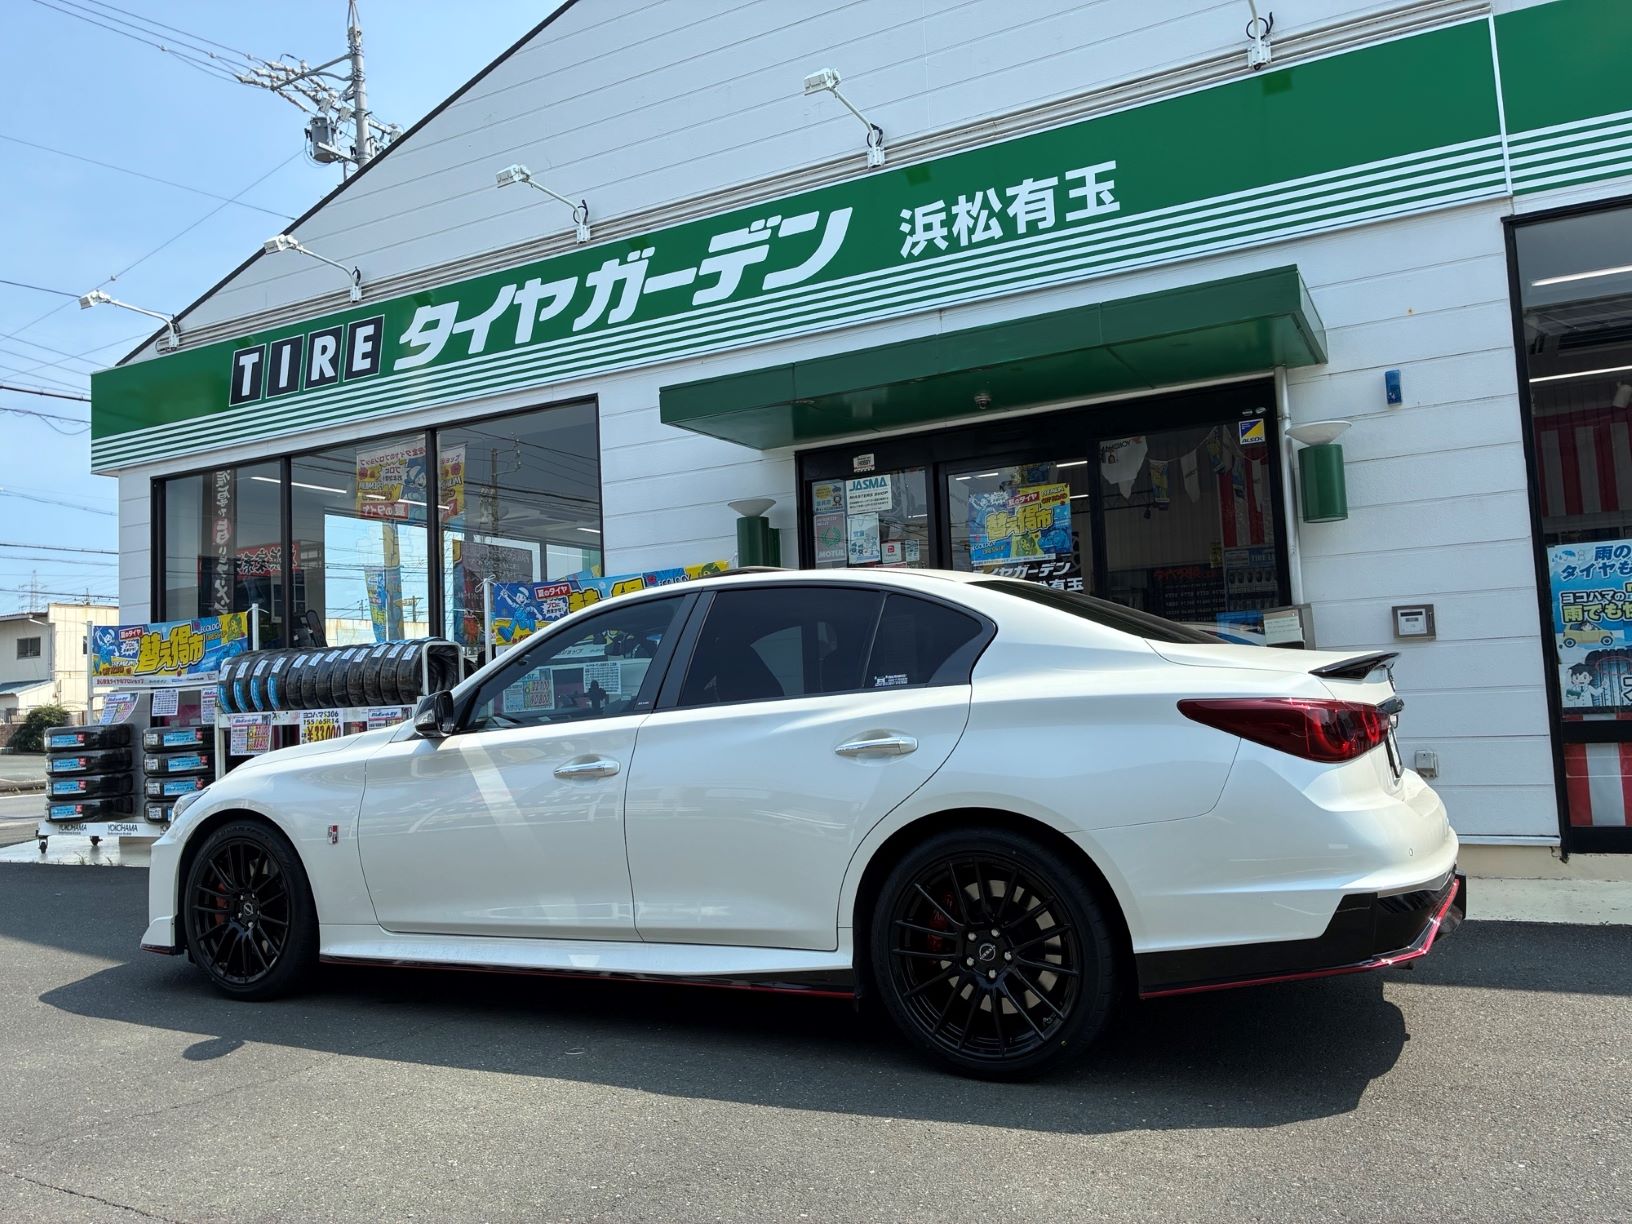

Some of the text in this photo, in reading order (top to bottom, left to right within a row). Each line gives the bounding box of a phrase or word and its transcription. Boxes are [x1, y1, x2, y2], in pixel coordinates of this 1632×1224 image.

[237, 160, 1121, 397] TIRE タイヤガーデン 浜松有玉
[849, 476, 888, 492] JASMA
[1008, 492, 1038, 507] 夏のタイヤ
[1594, 544, 1632, 562] 雨の
[1561, 561, 1632, 580] タイヤも
[538, 586, 569, 599] 夏のタイヤ
[1562, 591, 1625, 604] ヨコハマの
[134, 625, 205, 673] 替え得市
[58, 824, 87, 832] YOKOHAMA
[107, 823, 138, 832] YOKOHAMA
